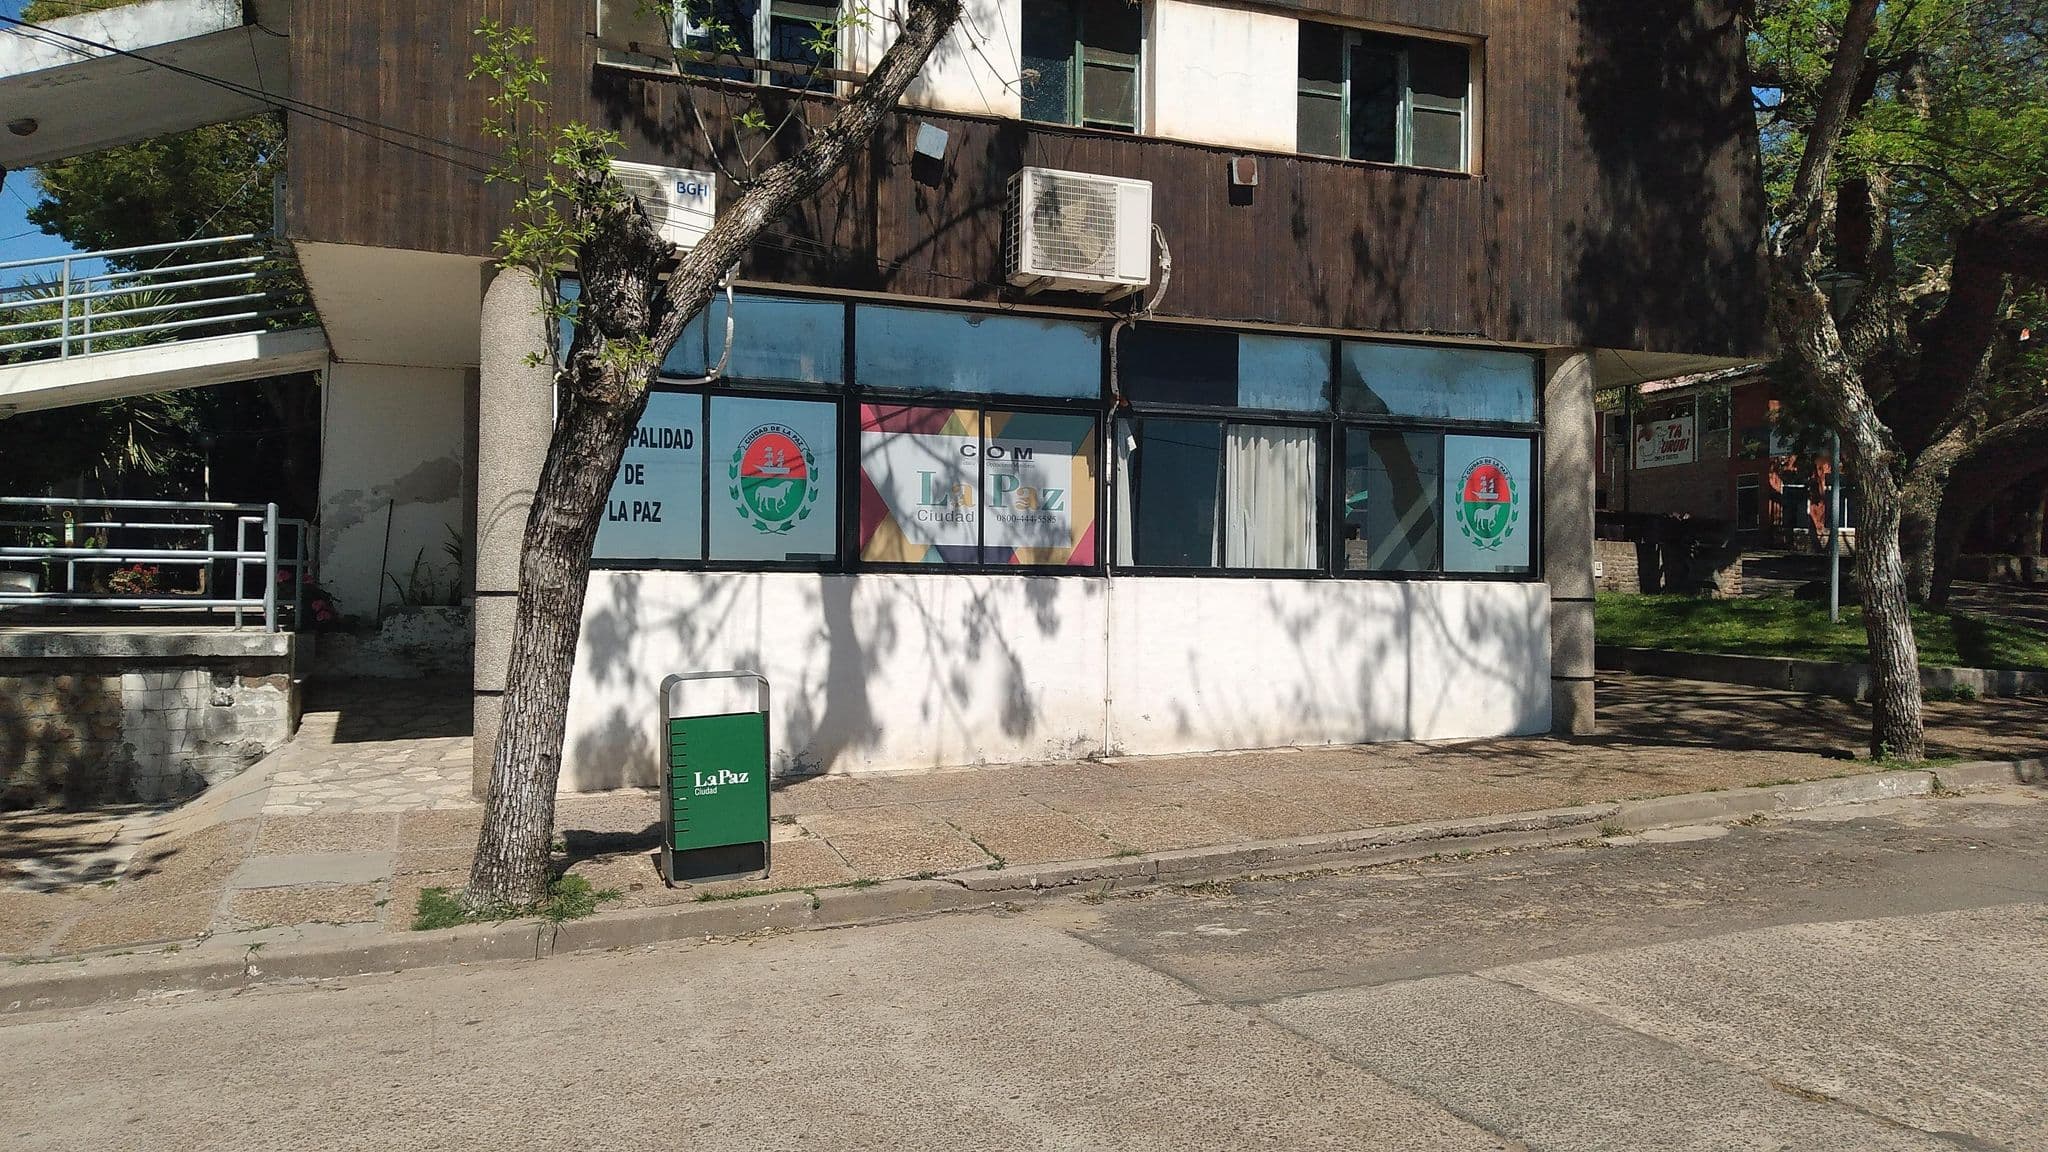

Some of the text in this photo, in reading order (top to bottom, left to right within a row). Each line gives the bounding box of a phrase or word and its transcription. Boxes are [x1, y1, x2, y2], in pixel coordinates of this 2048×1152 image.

[676, 182, 708, 197] BGH
[628, 427, 693, 449] PALIDAD
[745, 427, 768, 444] CIUDAD
[792, 435, 803, 446] PAZ
[625, 464, 644, 485] DE
[916, 471, 1065, 512] La Paz
[608, 500, 661, 522] LA PAZ
[917, 508, 974, 523] Ciudad
[694, 787, 717, 796] Ciudad
